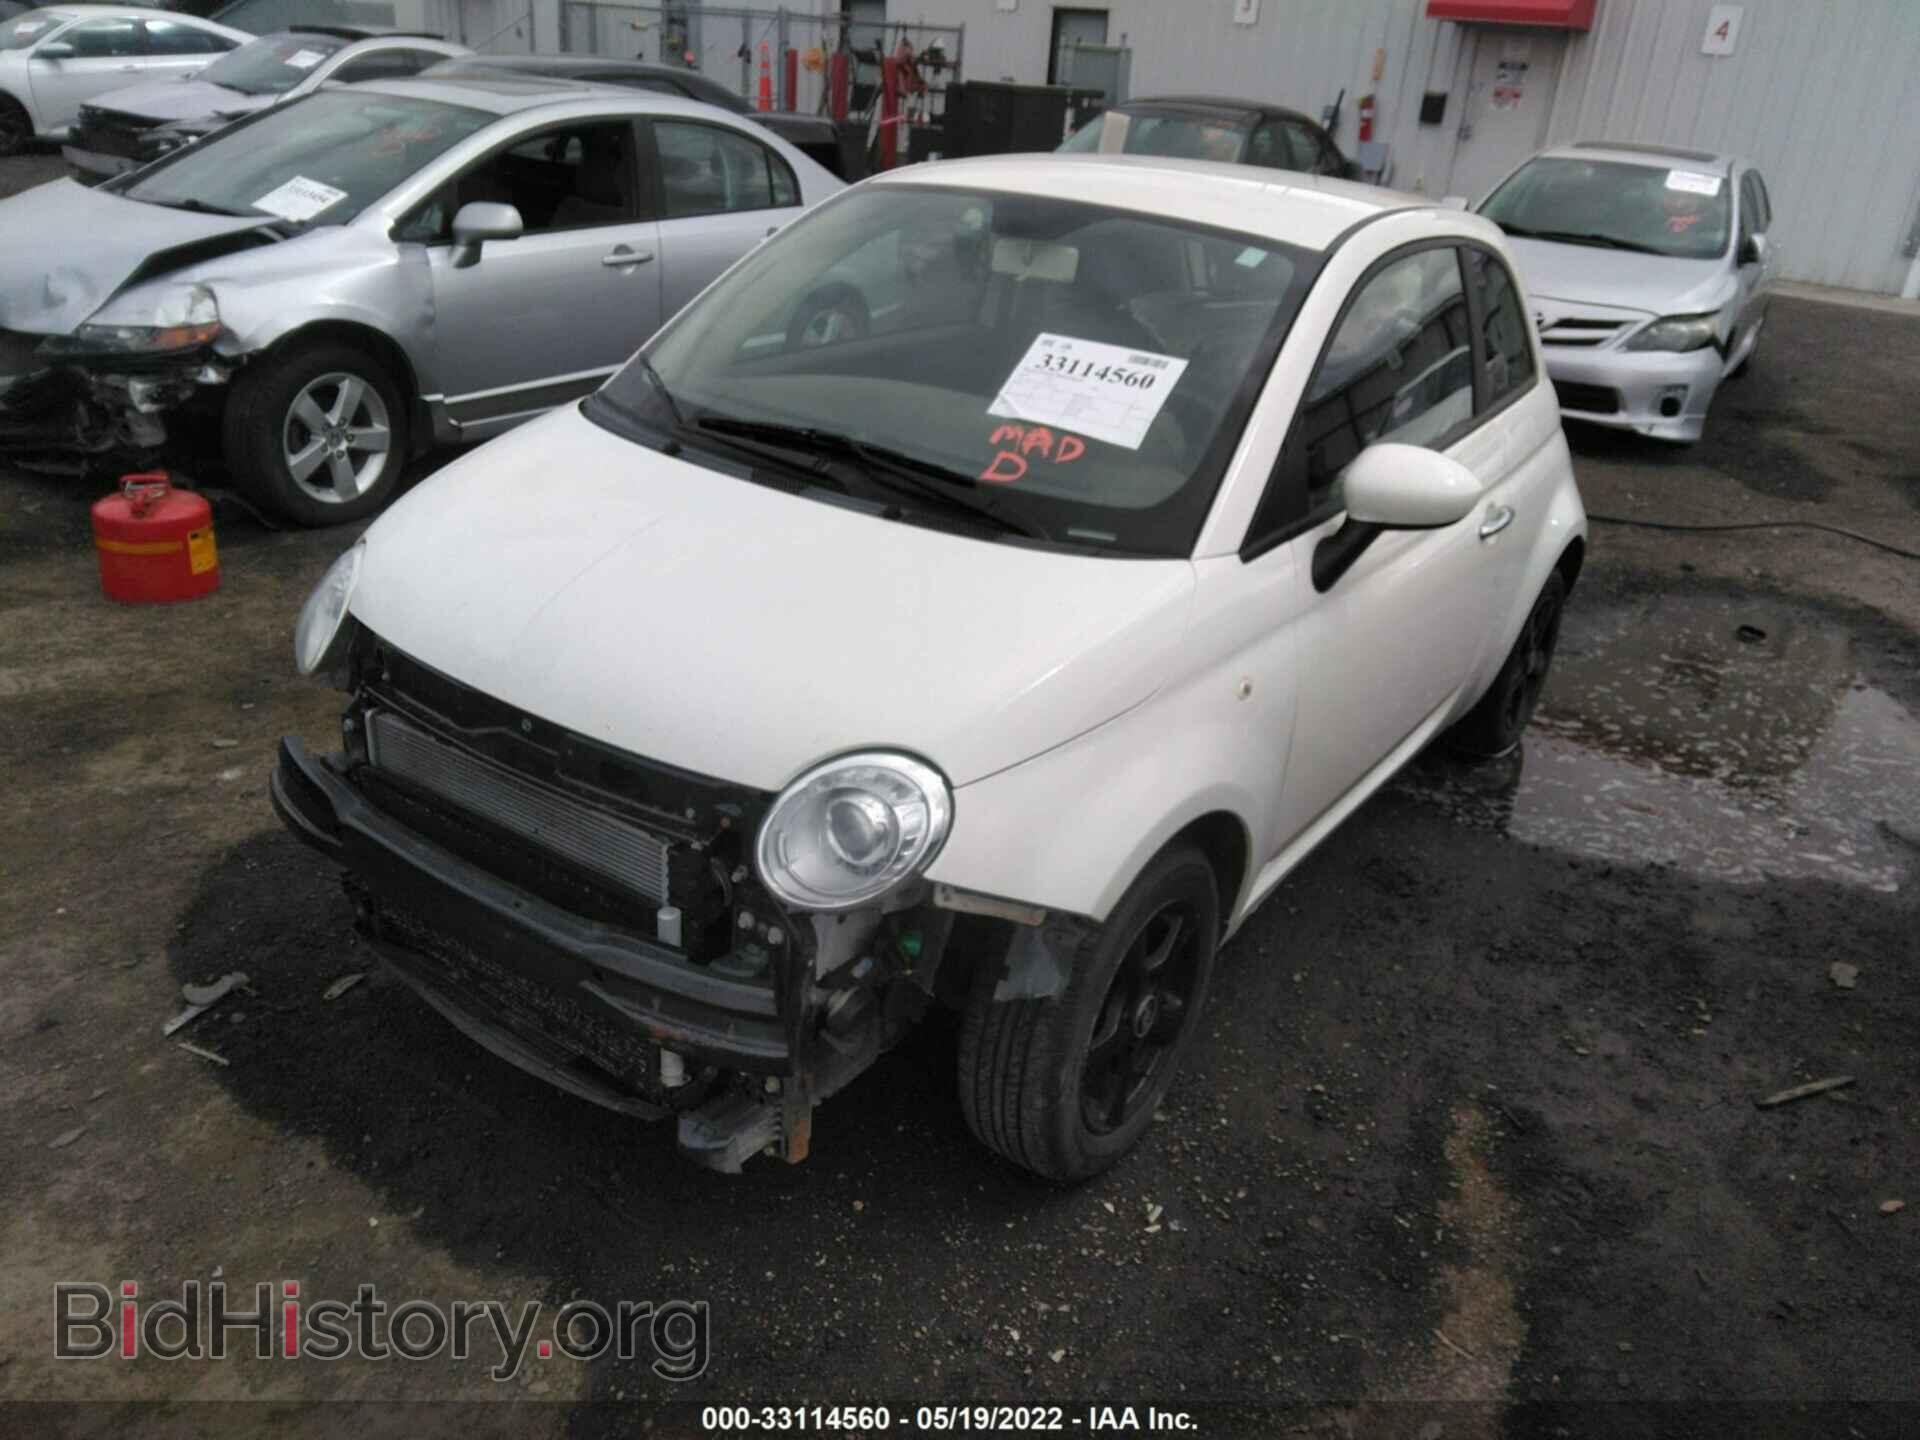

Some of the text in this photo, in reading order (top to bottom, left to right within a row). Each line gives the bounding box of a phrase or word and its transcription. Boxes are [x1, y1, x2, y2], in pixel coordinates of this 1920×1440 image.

[1715, 20, 1730, 41] 4
[1035, 353, 1156, 390] 33114560
[989, 425, 1085, 463] MAD
